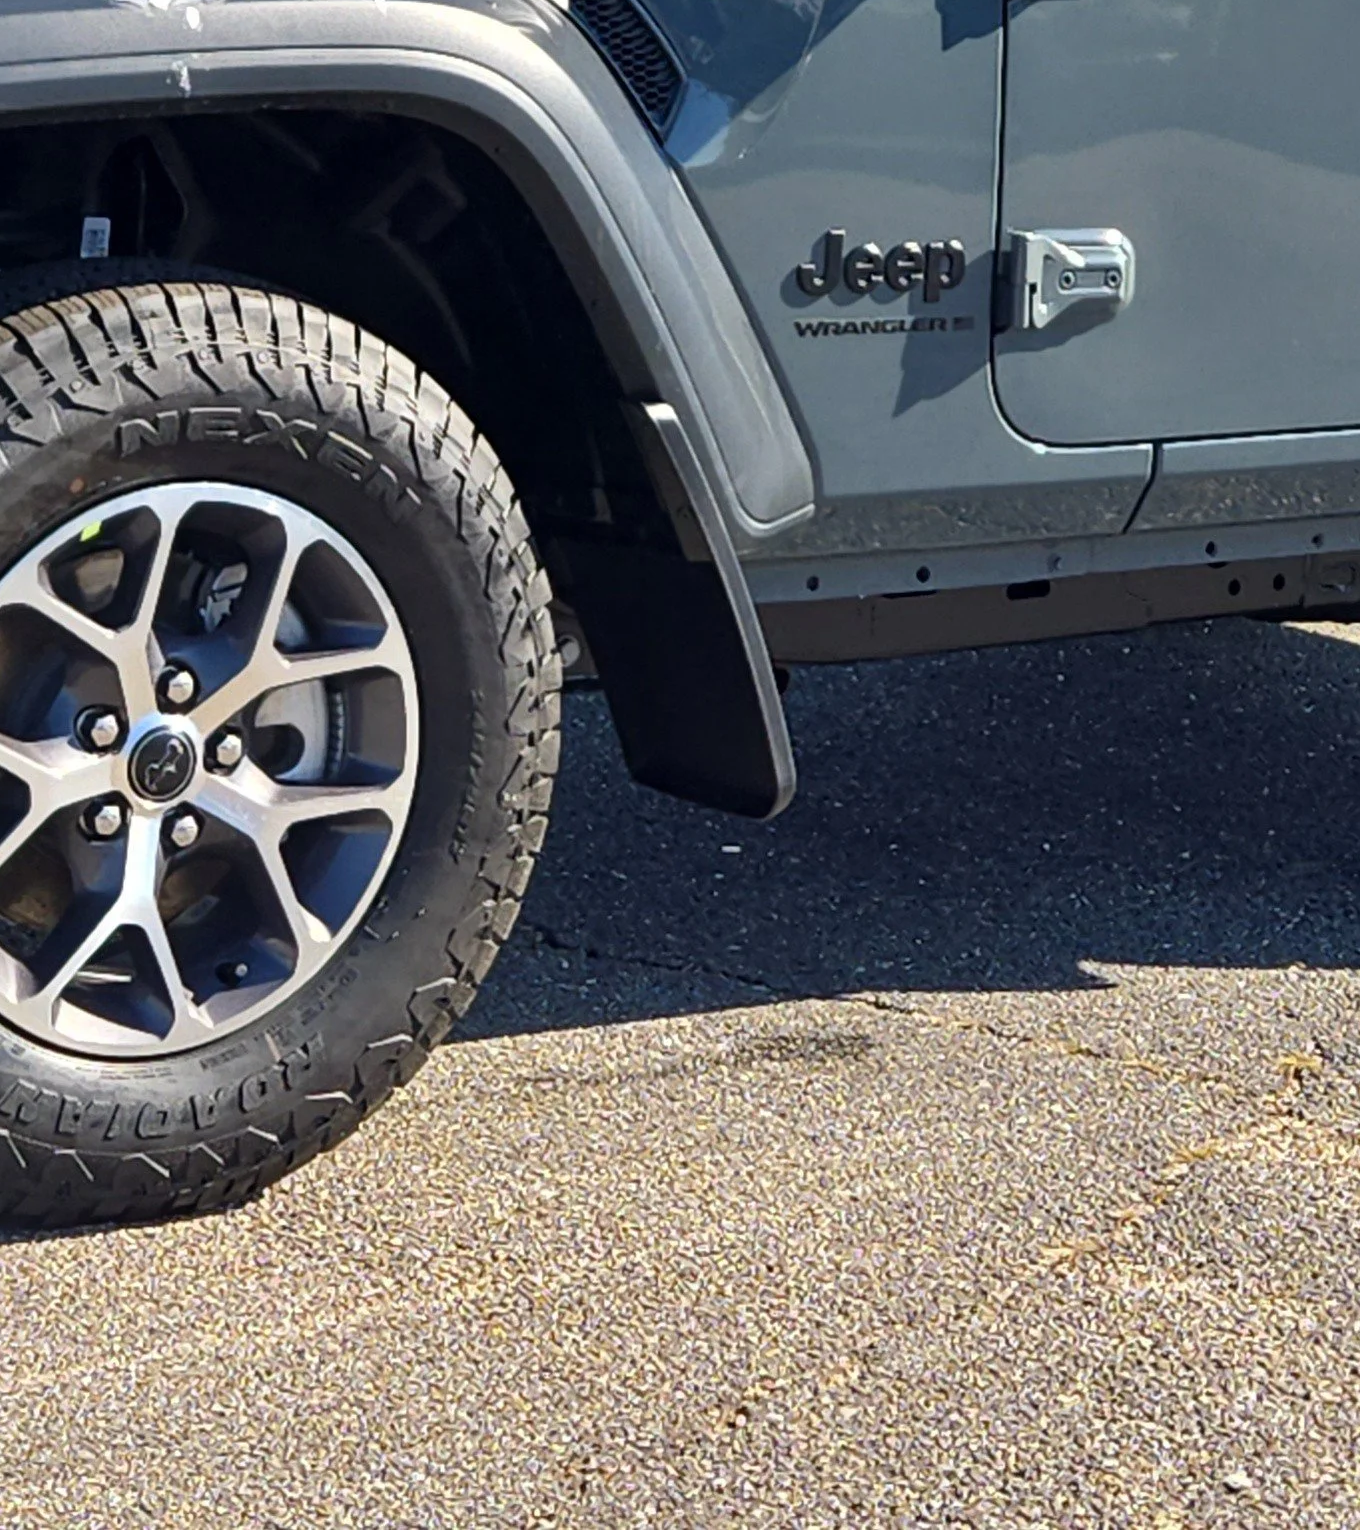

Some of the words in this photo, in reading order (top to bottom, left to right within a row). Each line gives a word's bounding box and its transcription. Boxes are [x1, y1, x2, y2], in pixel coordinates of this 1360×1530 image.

[795, 227, 966, 304] Jeep
[793, 316, 948, 338] WRANGLER
[114, 406, 424, 520] NEXEN
